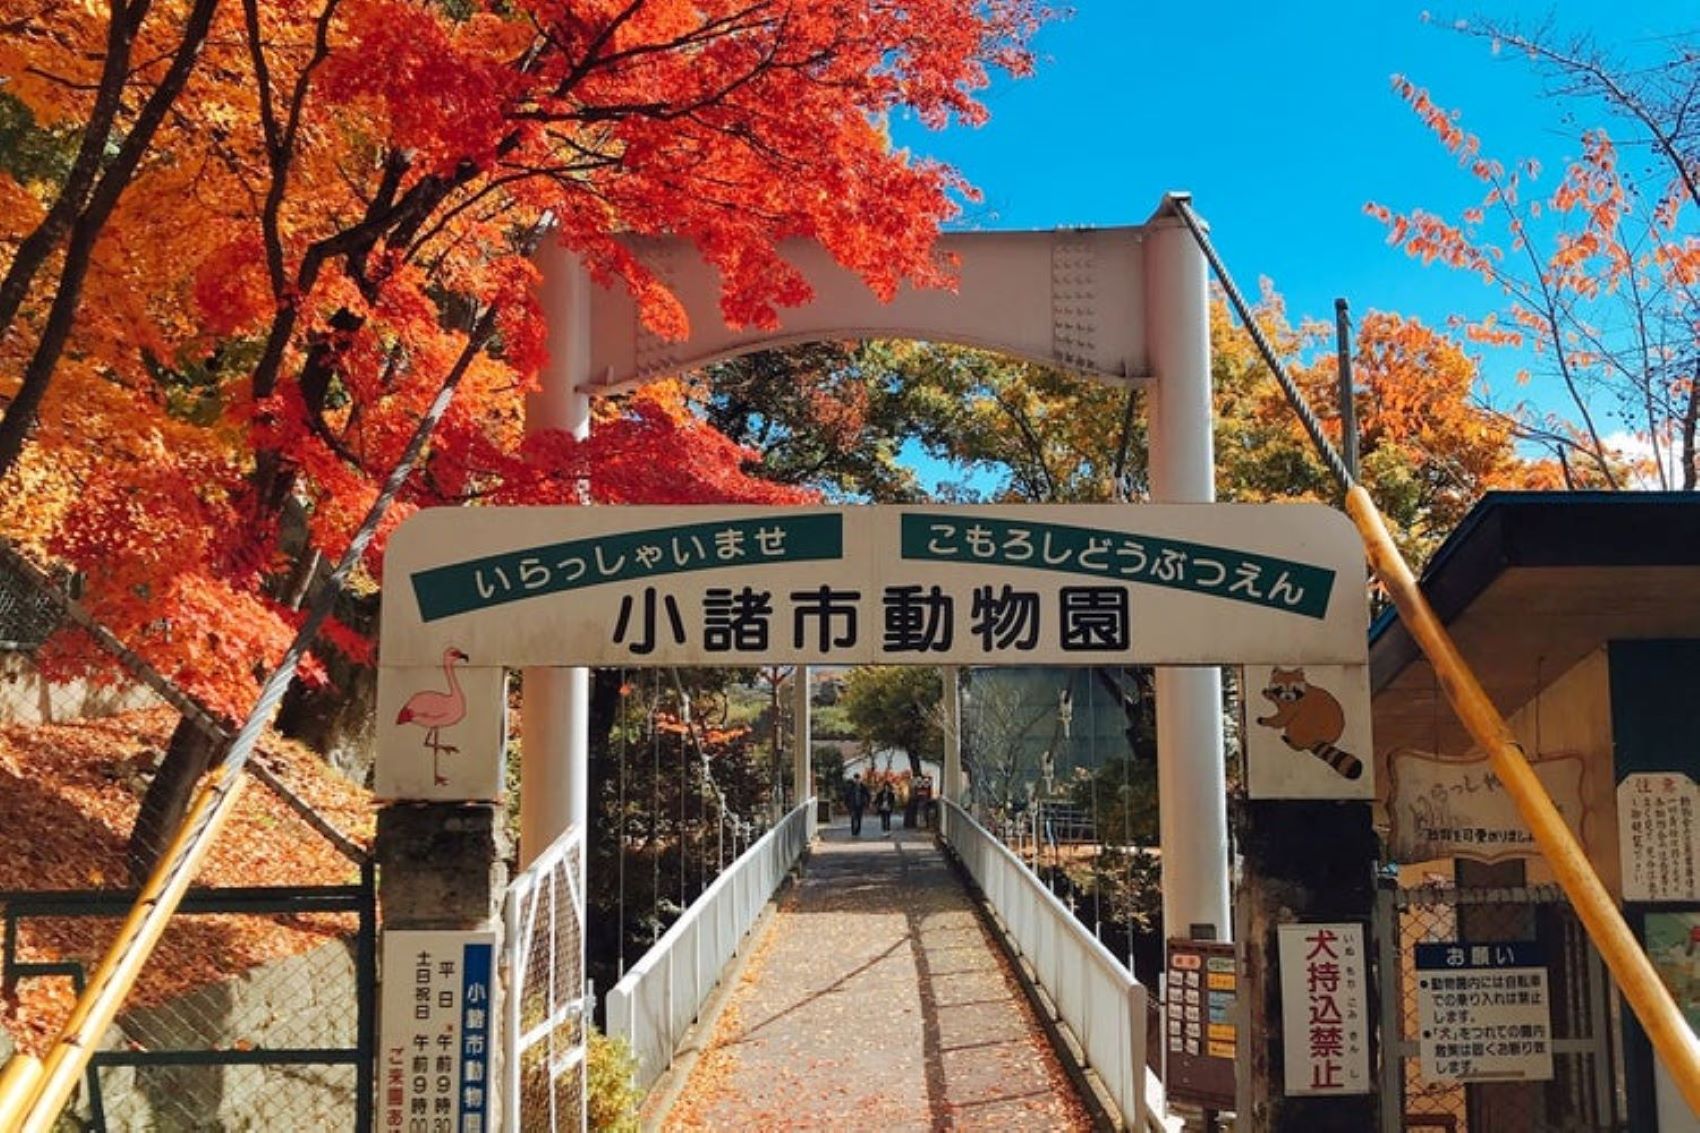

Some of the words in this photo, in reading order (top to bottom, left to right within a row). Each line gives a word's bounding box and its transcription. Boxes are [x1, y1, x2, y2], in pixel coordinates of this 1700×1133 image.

[475, 525, 787, 599] いらっしゃいませ
[928, 523, 1305, 606] こもろしどうぶつえん
[612, 583, 1130, 654] 小諸市動物園
[1343, 933, 1355, 956] いぬ
[1446, 946, 1515, 966] お願い
[415, 950, 432, 1020] 土日祝日
[439, 961, 455, 1008] 平日
[1304, 929, 1345, 1089] 犬持込禁止
[1432, 992, 1542, 1007] での乗り入れは禁止
[1433, 1010, 1476, 1024] します。
[386, 1047, 405, 1133] ご来園お
[1436, 1060, 1478, 1075] します。
